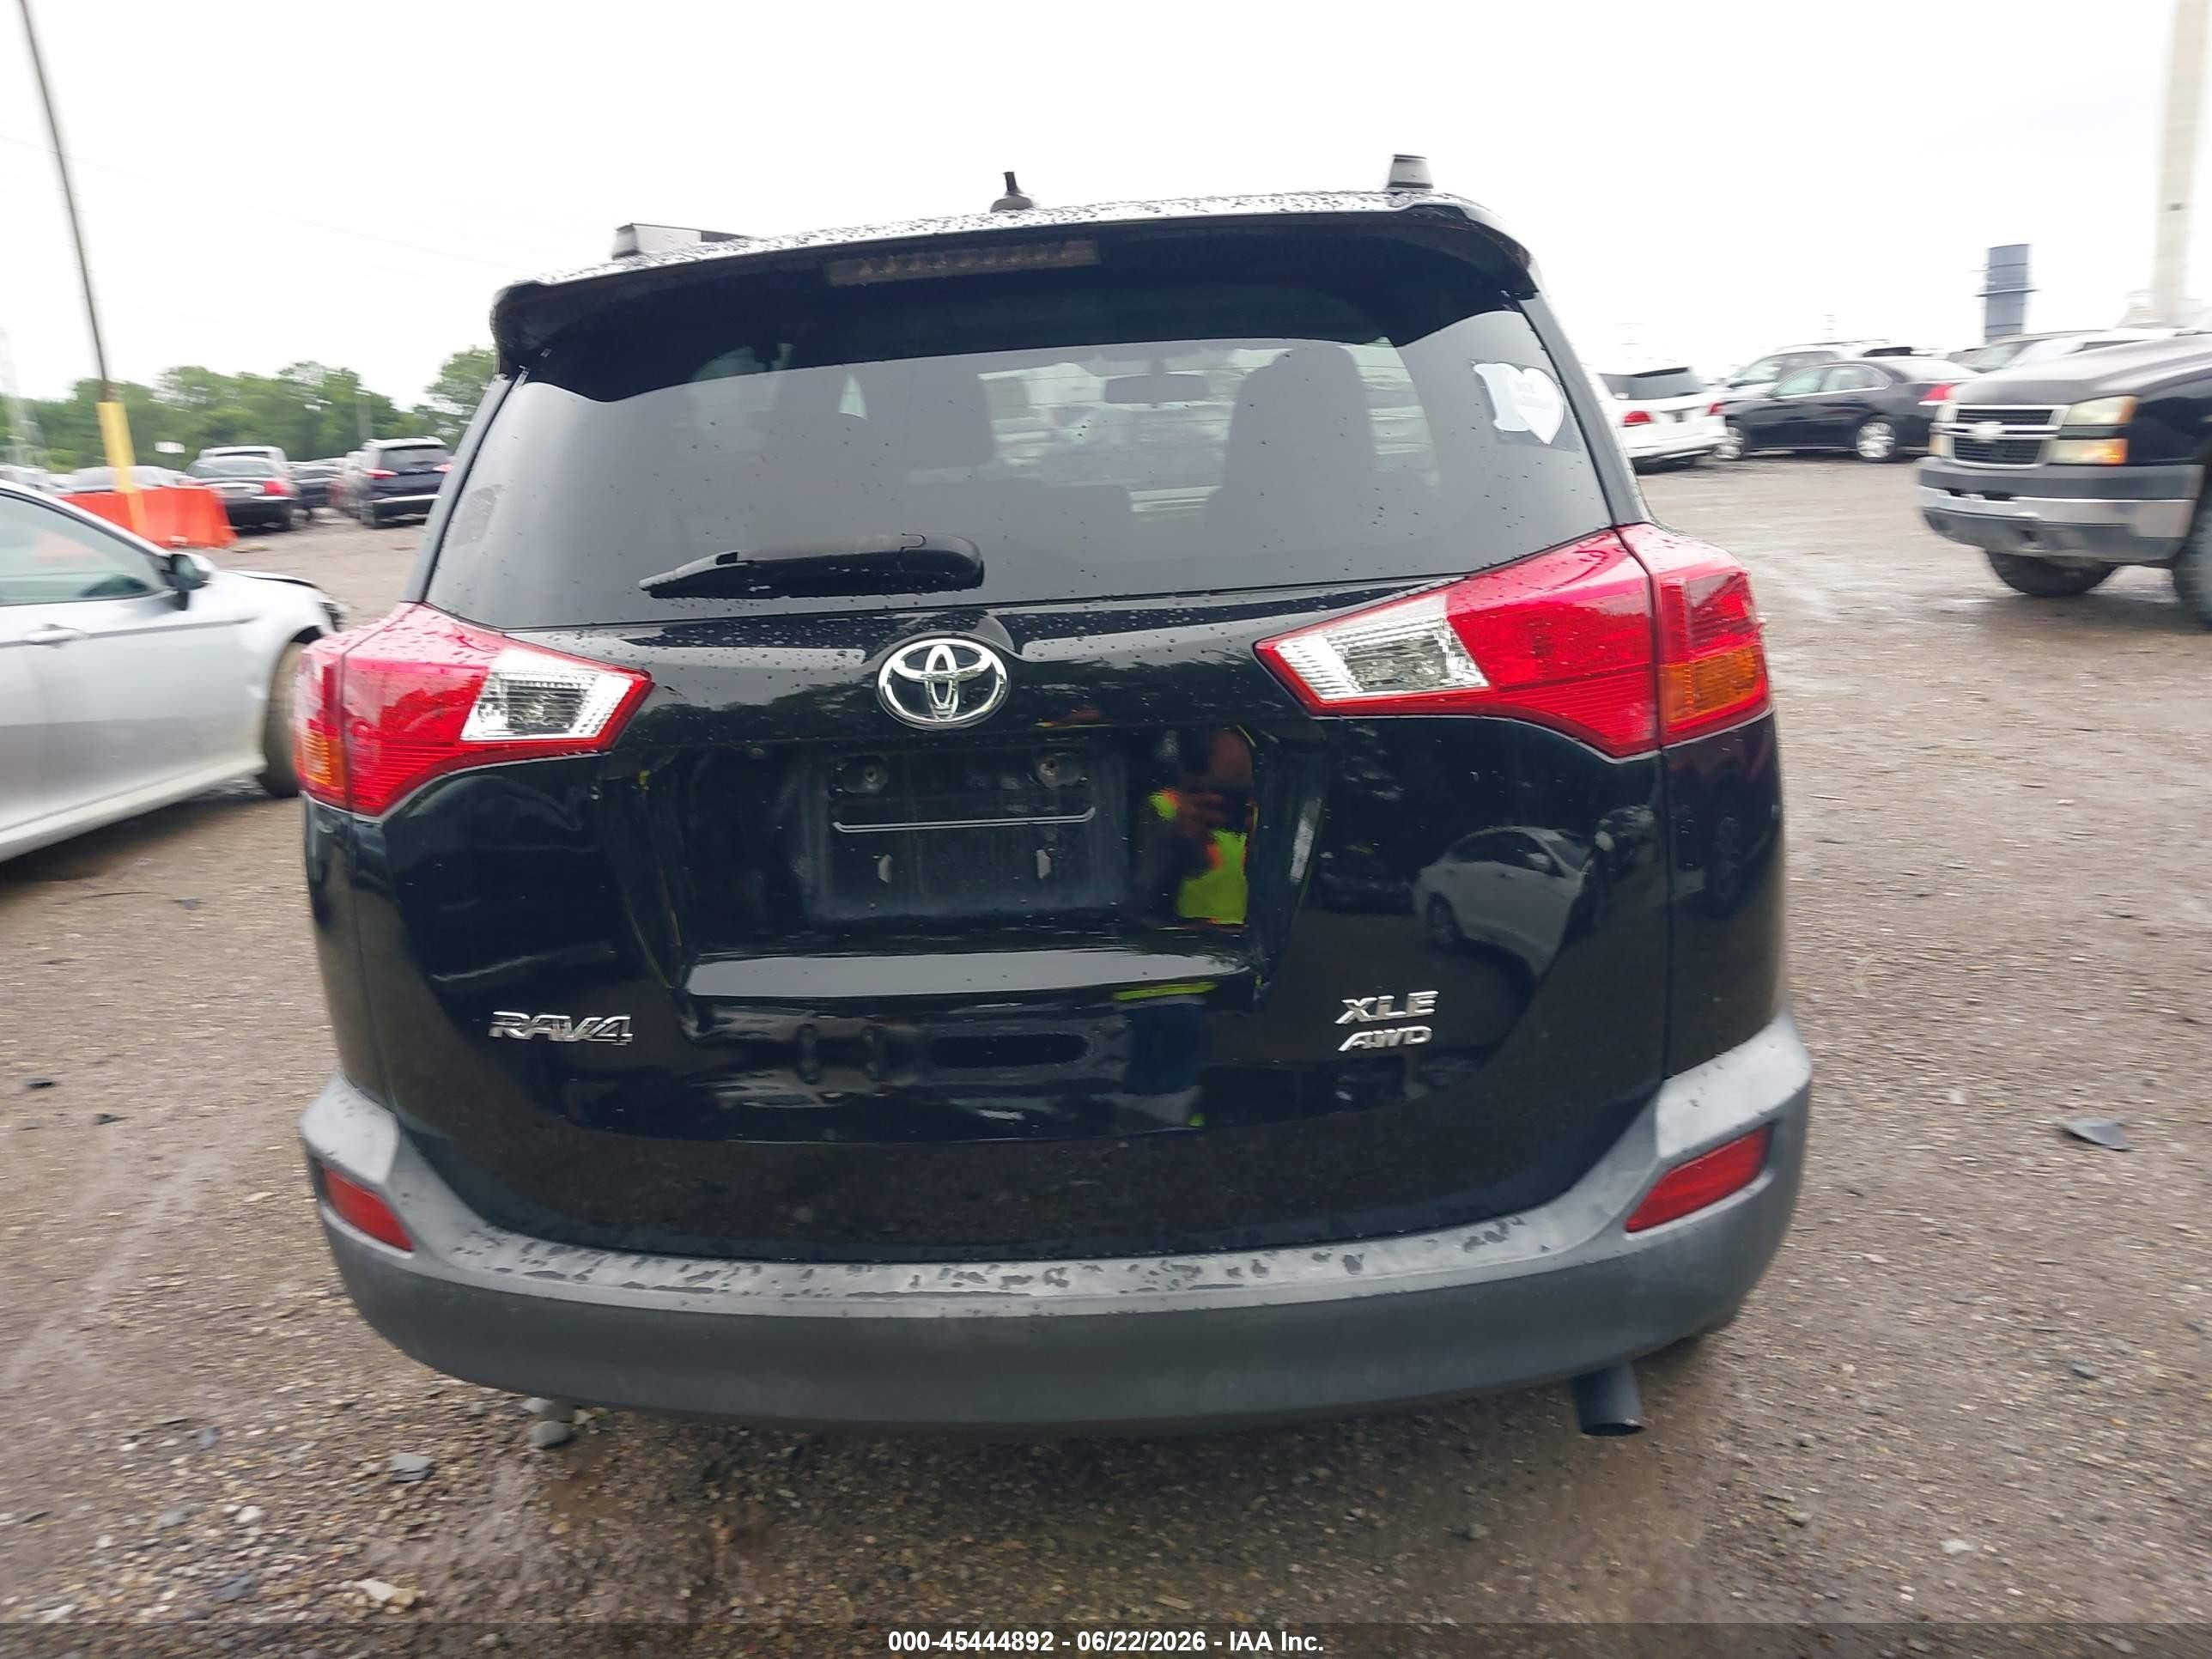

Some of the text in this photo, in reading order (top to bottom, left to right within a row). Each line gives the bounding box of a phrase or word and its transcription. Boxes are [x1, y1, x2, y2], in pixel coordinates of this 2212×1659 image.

[1334, 990, 1439, 1024] XLE
[488, 1011, 634, 1046] RAV4
[1337, 1025, 1433, 1052] AWD
